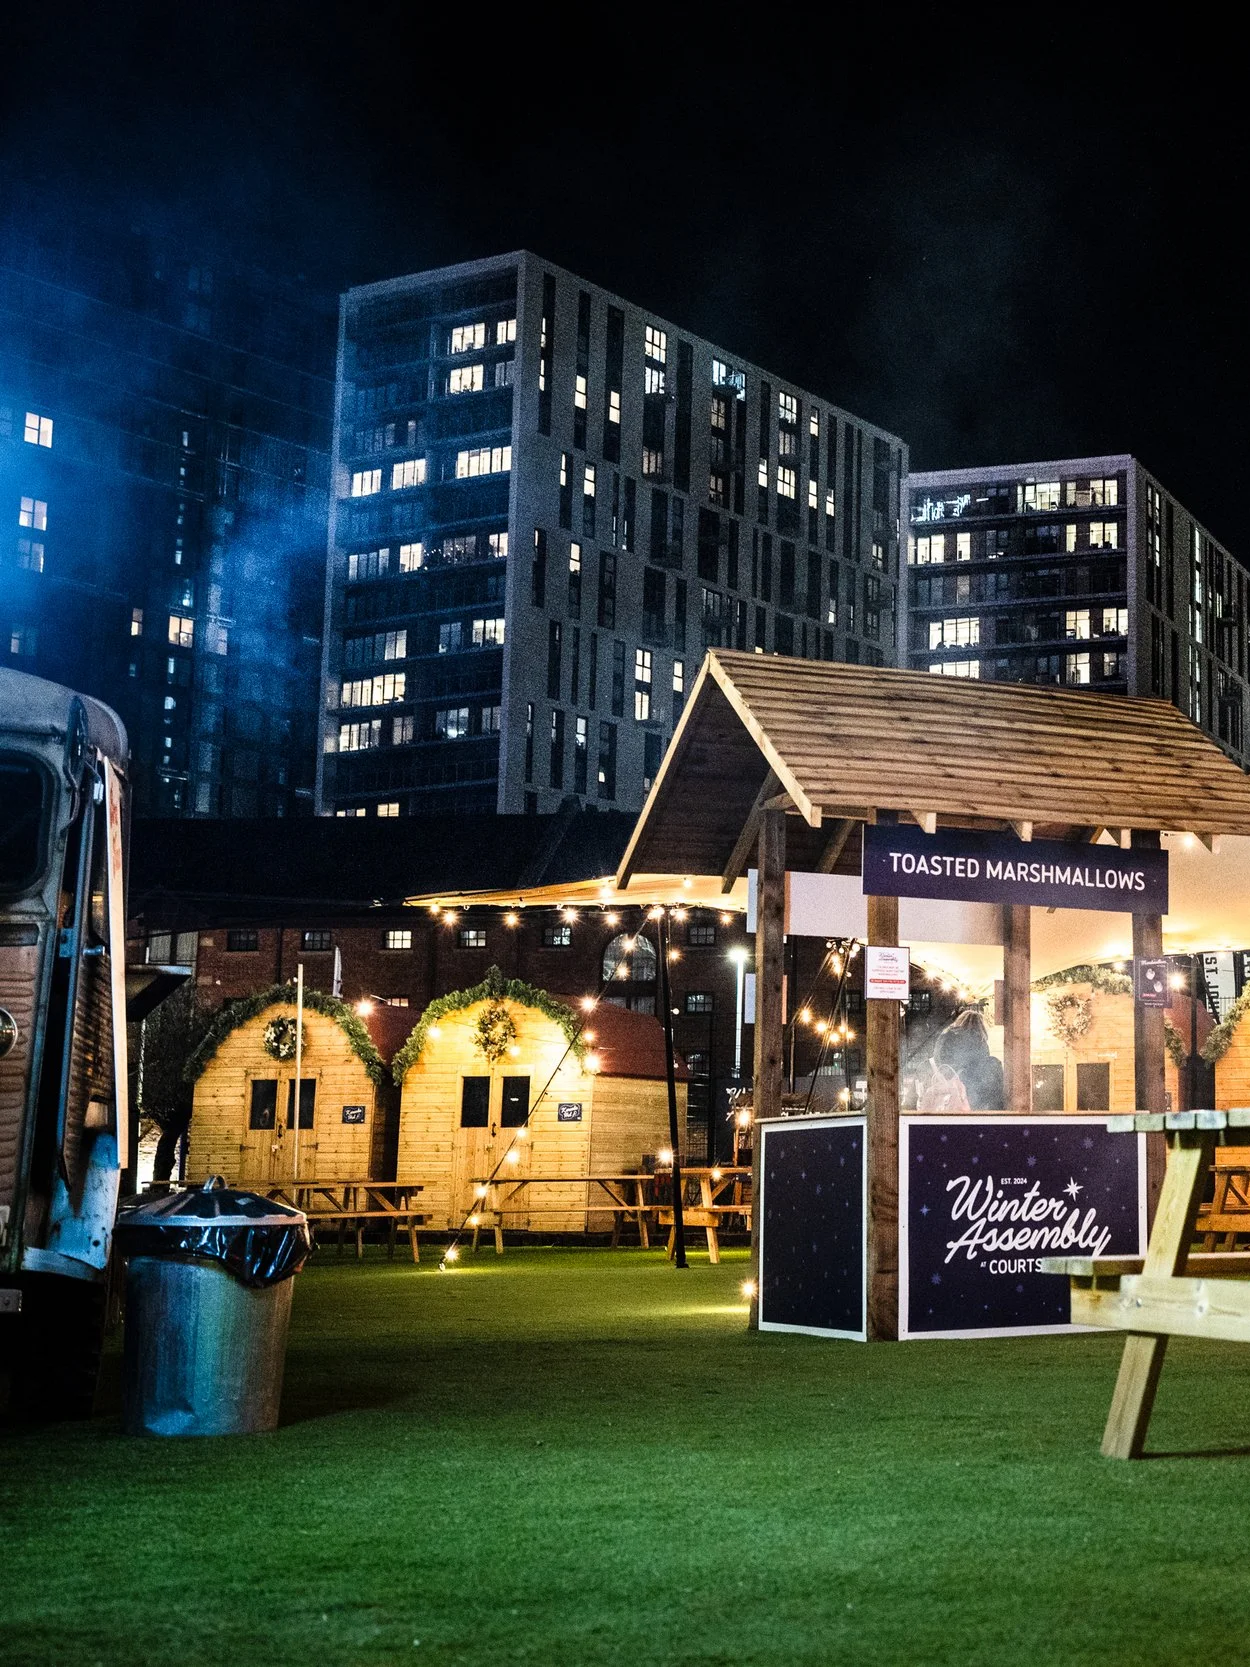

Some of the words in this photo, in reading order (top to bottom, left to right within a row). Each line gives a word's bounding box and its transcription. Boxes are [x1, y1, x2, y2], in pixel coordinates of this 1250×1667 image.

[889, 853, 980, 878] TOASTED
[986, 860, 1146, 891] MARSHMALLOWS
[946, 1175, 1067, 1222] Winter
[944, 1208, 1111, 1264] Assembly
